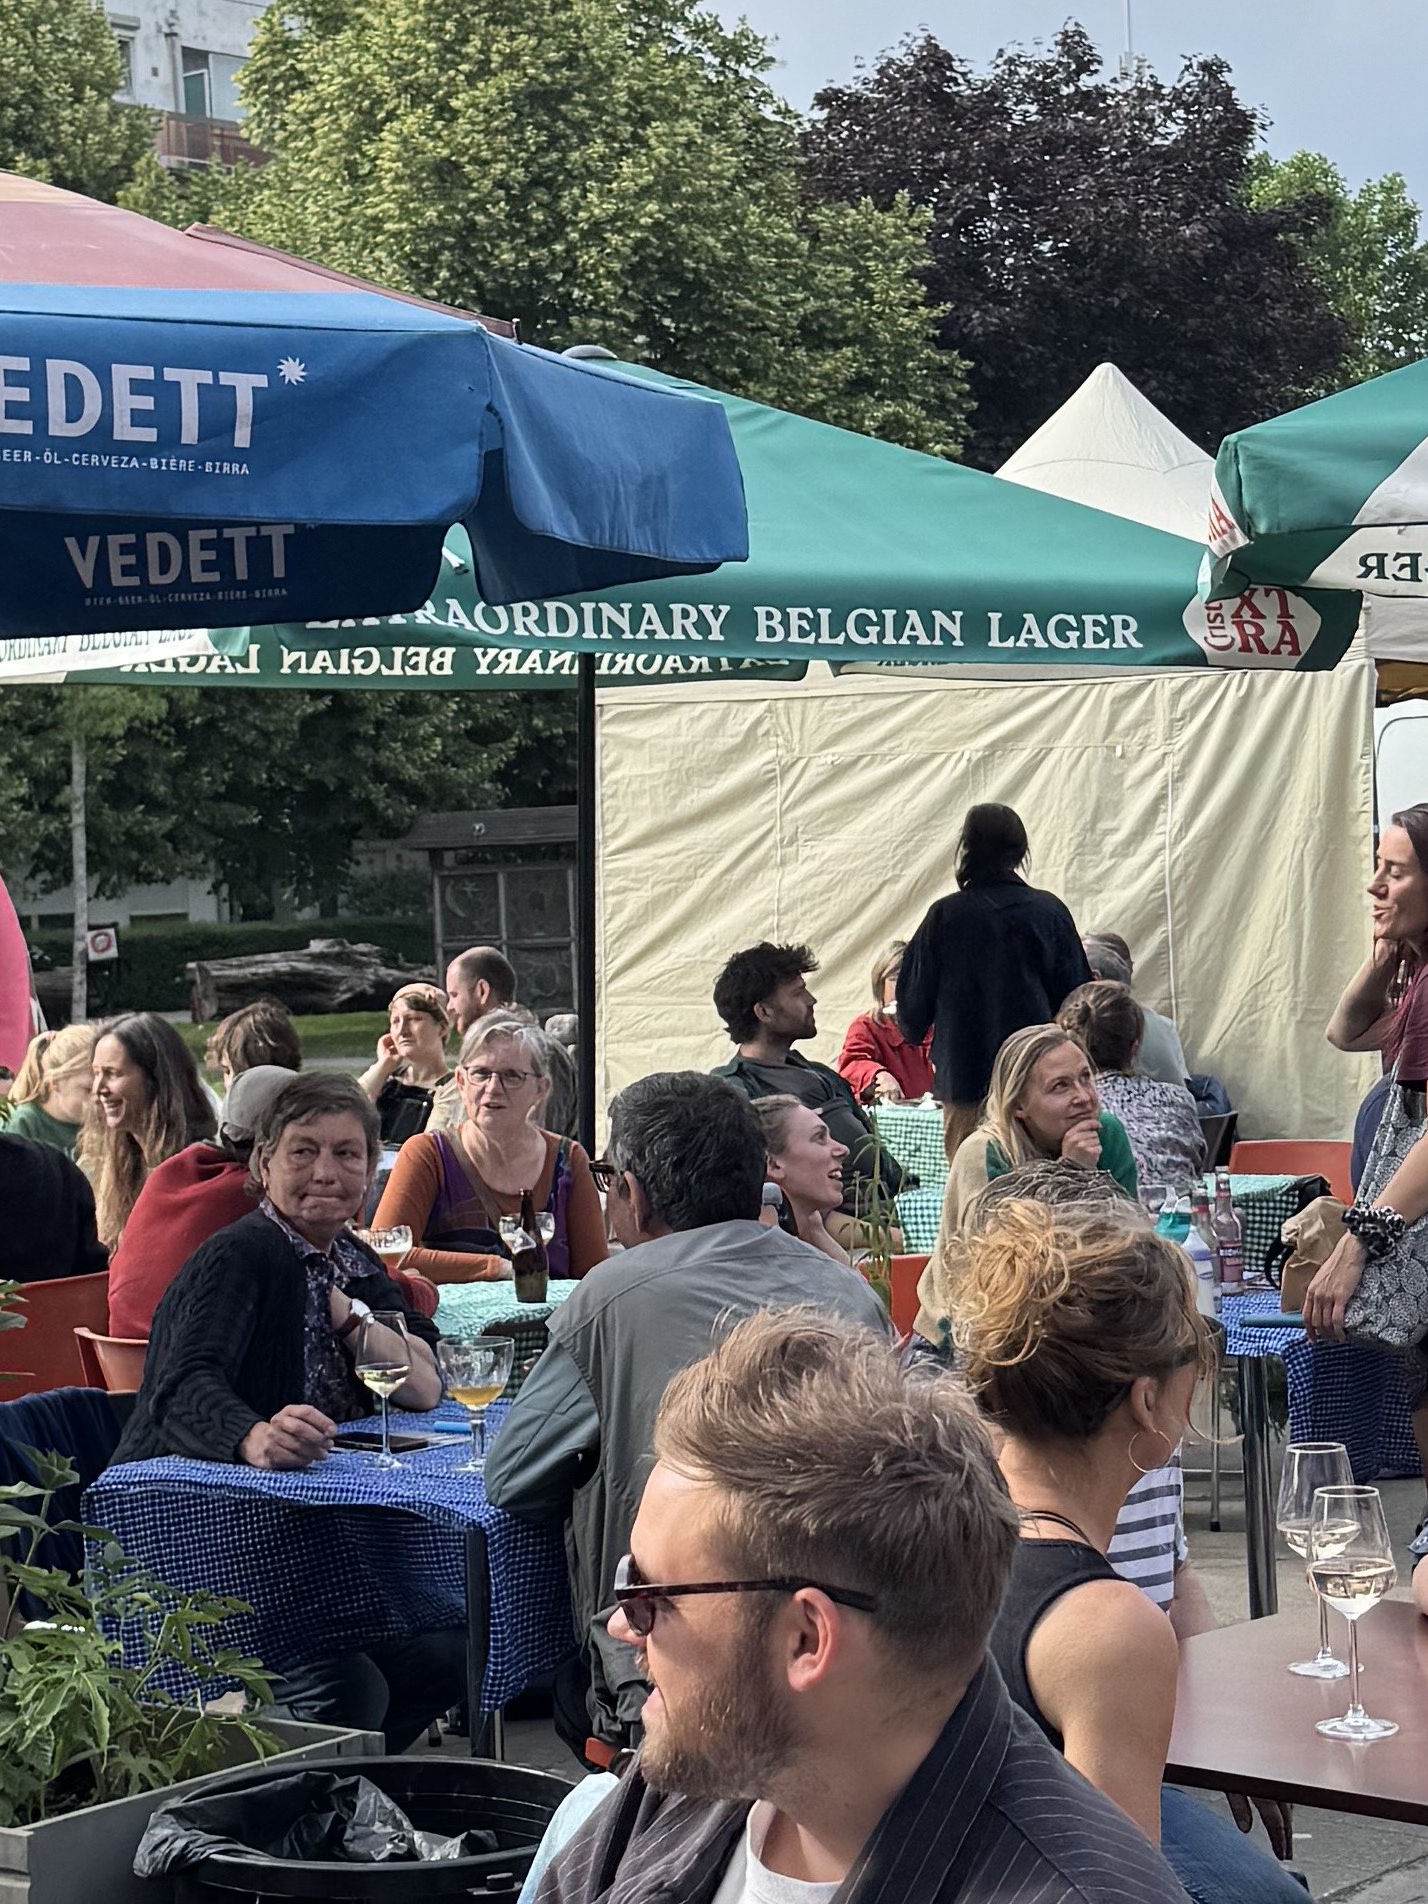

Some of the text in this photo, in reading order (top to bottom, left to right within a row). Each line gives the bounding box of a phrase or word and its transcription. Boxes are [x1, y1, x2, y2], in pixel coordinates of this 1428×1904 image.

[64, 524, 295, 589] VEDETT
[305, 598, 1143, 649] RAORDINARY BELGIAN LAGER
